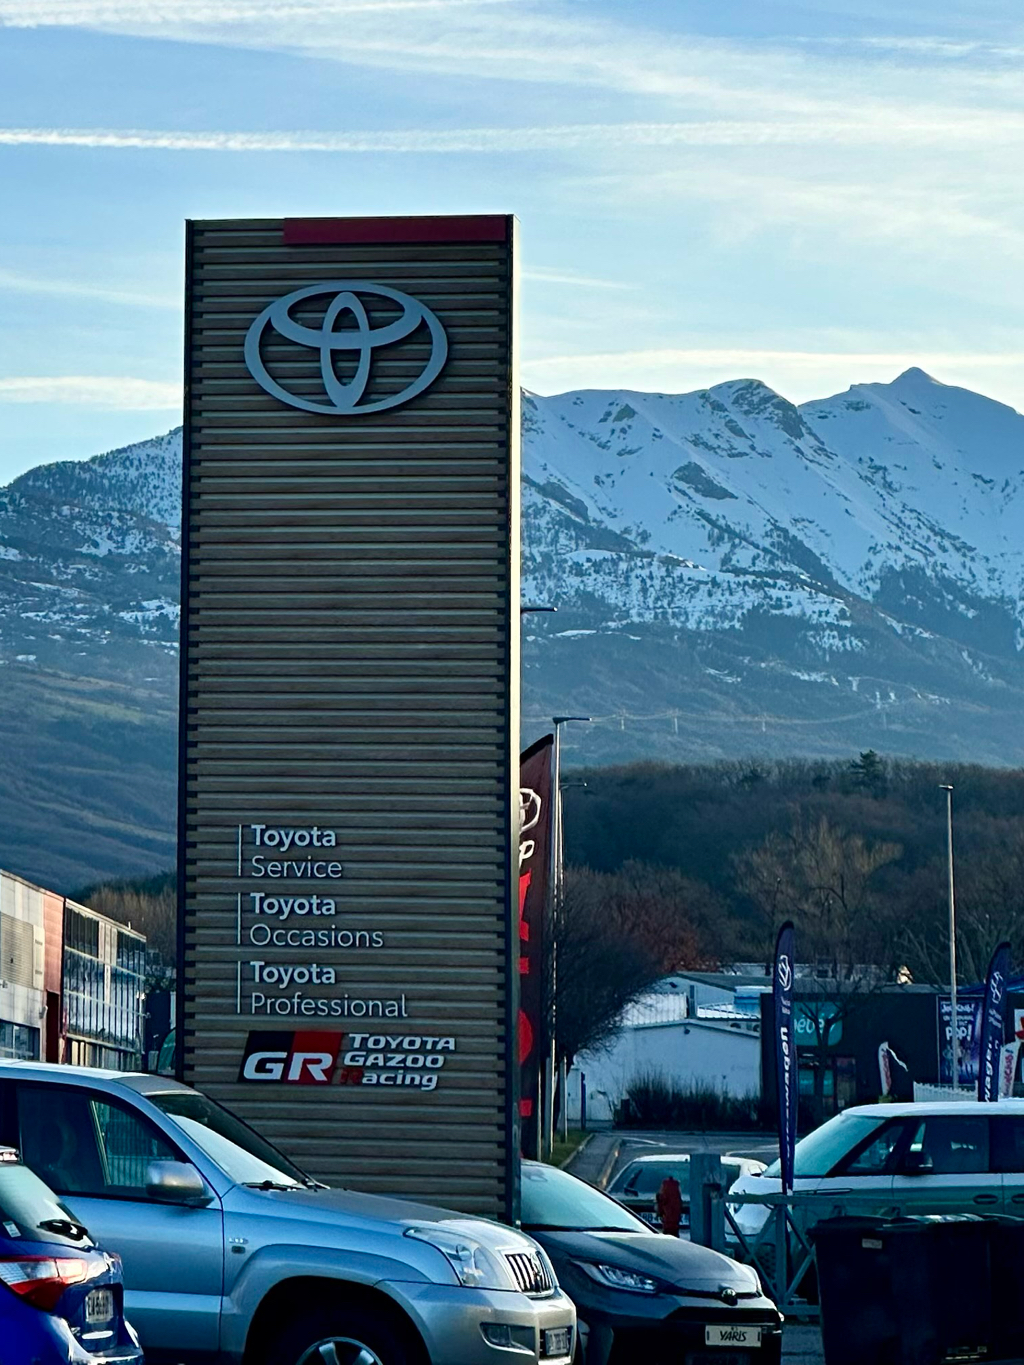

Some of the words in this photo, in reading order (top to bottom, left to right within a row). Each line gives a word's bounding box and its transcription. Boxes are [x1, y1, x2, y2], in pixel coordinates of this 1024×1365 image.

[251, 824, 336, 851] Toyota
[251, 855, 342, 878] Service
[250, 892, 336, 919] Toyota
[249, 923, 383, 948] Occasions
[250, 960, 336, 988] Toyota
[251, 991, 408, 1017] Professional
[348, 1033, 456, 1051] TOYOTA
[243, 1051, 333, 1081] GR
[343, 1051, 445, 1068] GAZOO
[339, 1068, 438, 1091] Racing
[719, 1330, 747, 1342] YARIS
